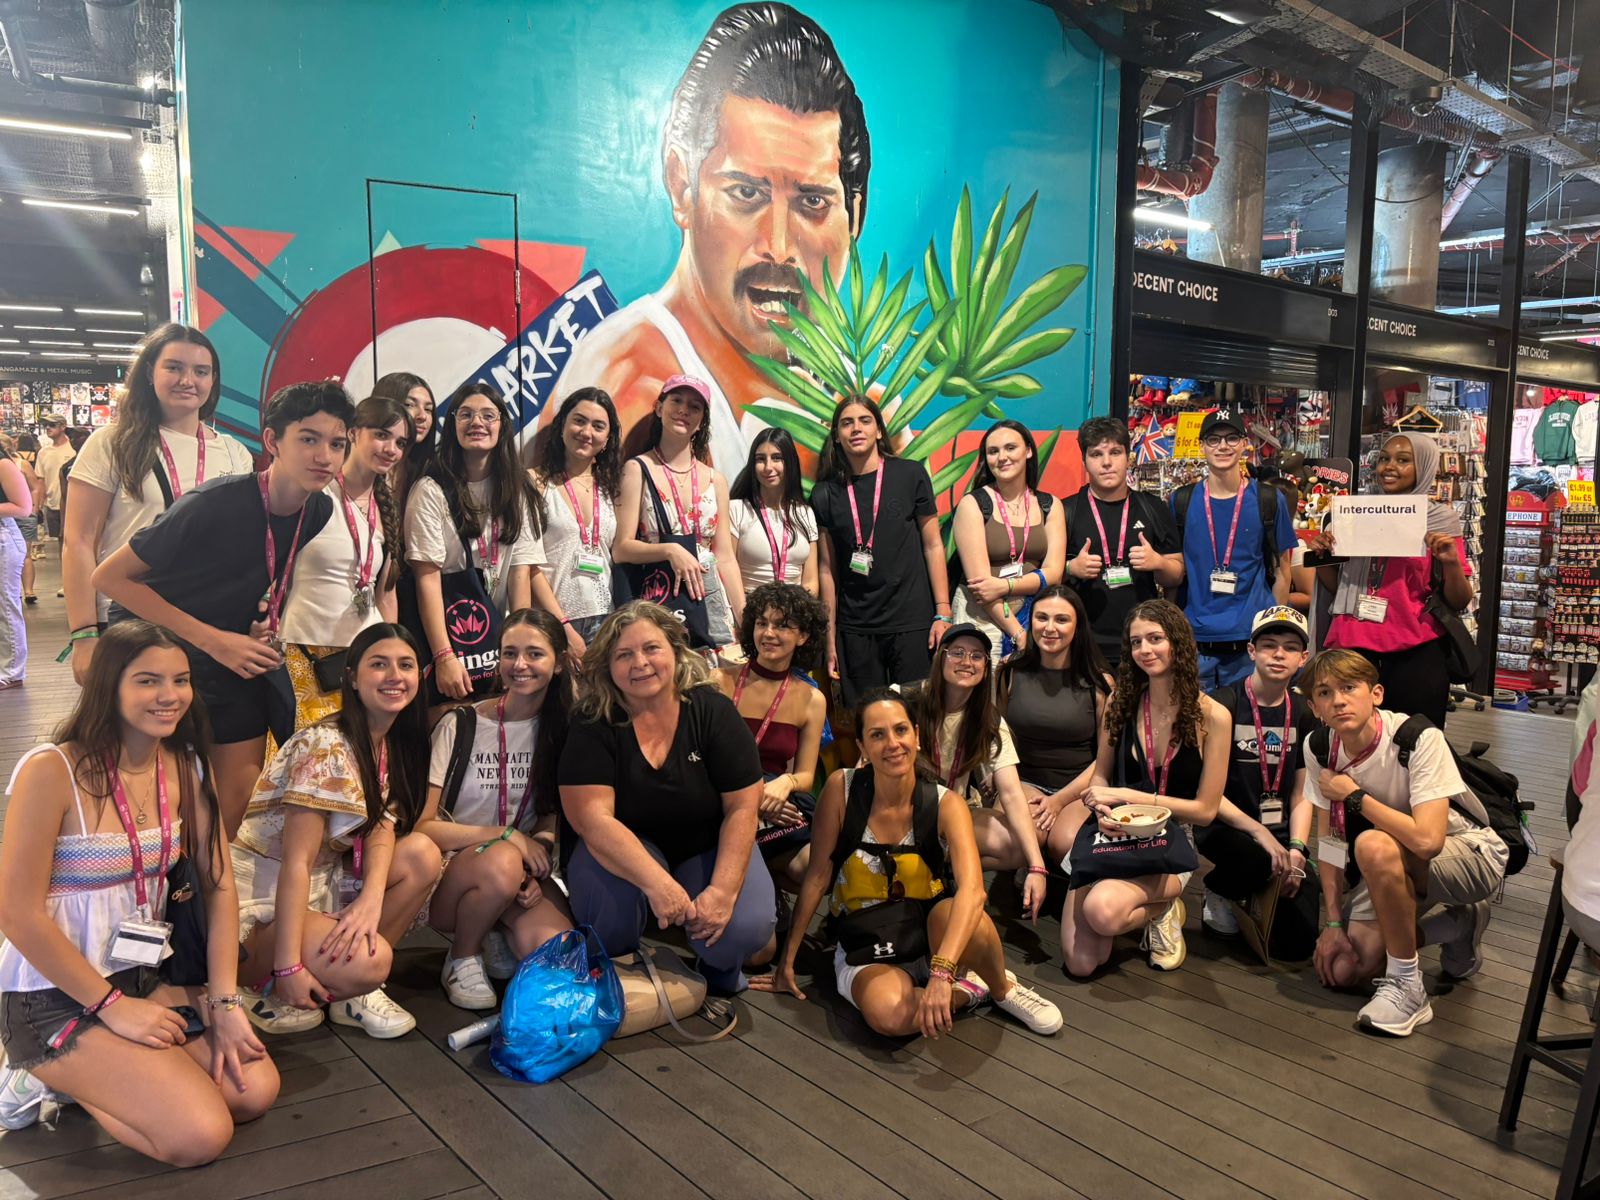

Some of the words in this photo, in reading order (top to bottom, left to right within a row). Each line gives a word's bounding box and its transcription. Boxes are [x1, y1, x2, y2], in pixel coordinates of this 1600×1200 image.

[1177, 280, 1219, 302] CHOICE
[1367, 316, 1389, 332] CENT
[1389, 321, 1417, 337] CHOICE
[470, 275, 604, 426] ARKET
[1530, 347, 1550, 360] CHOICE
[1216, 410, 1230, 420] NY
[1182, 436, 1192, 447] for
[1311, 465, 1349, 485] ORIES
[1583, 494, 1592, 502] £5
[1339, 504, 1417, 514] Intercultural
[1507, 512, 1539, 521] EPHONE
[457, 649, 500, 671] ing
[1248, 740, 1292, 752] Cuma
[474, 751, 531, 764] MANATT
[477, 767, 501, 779] NE
[511, 766, 530, 779] YO
[757, 829, 784, 843] cation
[1137, 842, 1150, 850] for
[1151, 838, 1168, 848] Life
